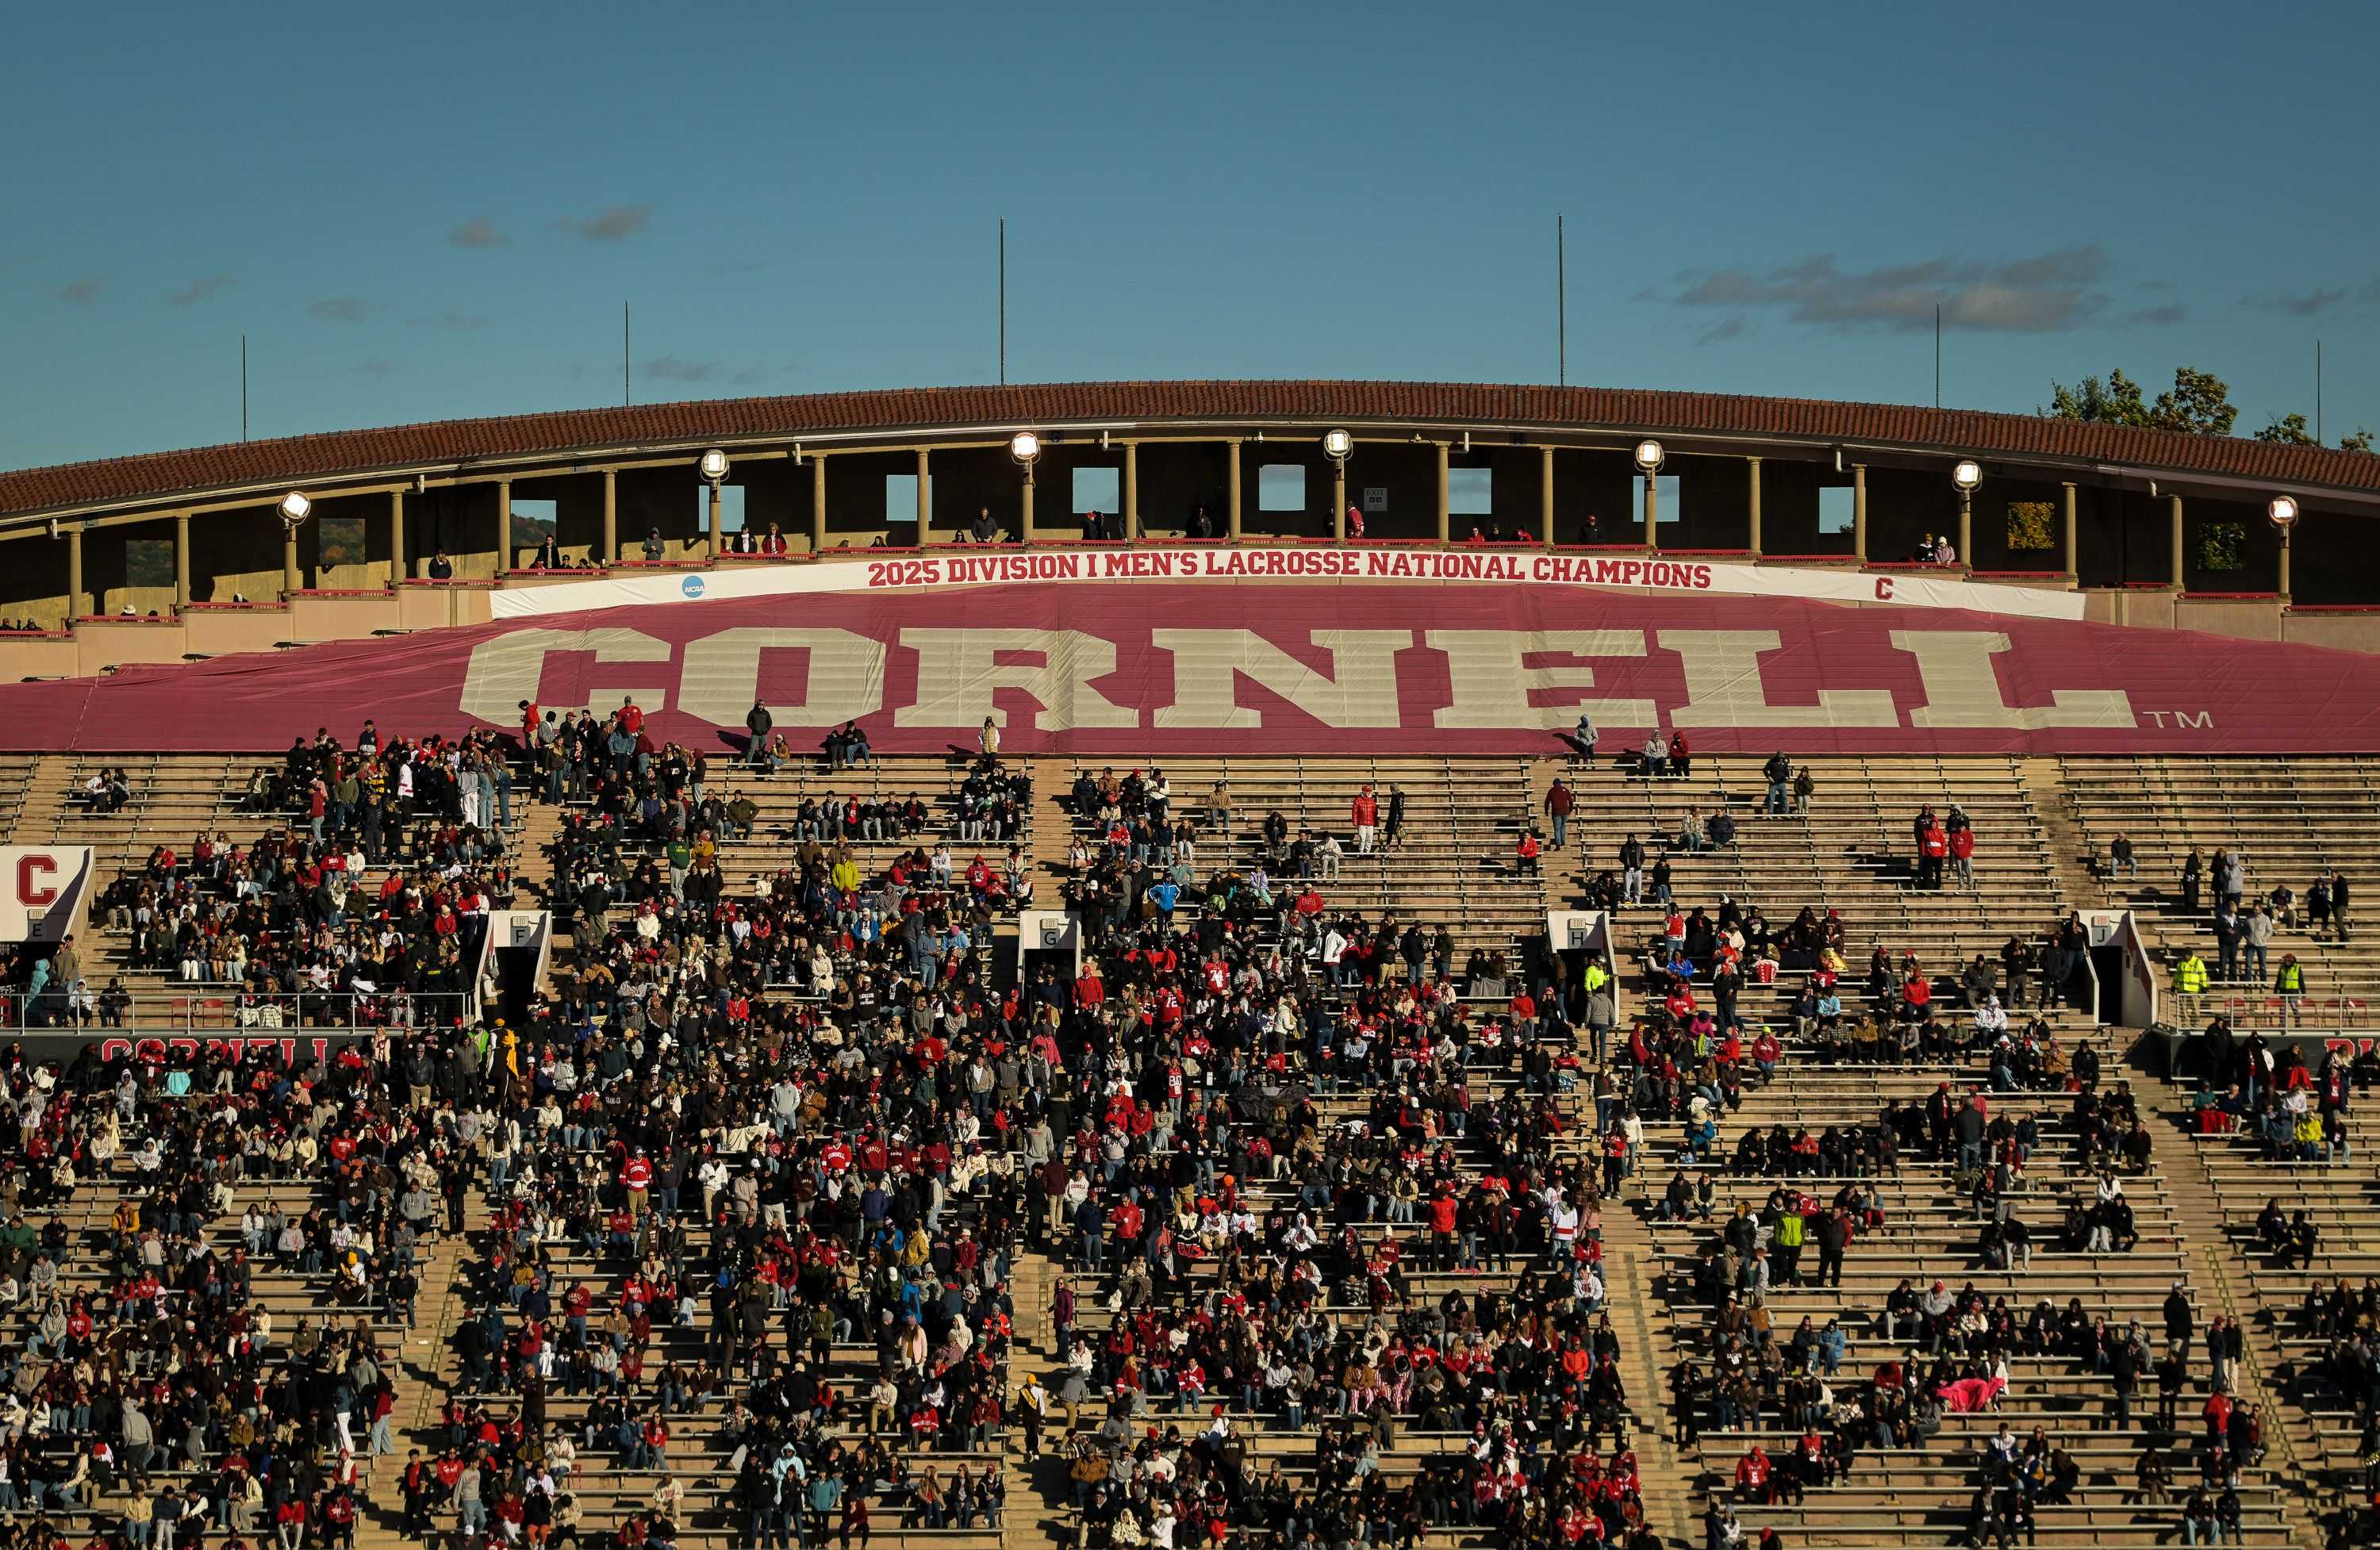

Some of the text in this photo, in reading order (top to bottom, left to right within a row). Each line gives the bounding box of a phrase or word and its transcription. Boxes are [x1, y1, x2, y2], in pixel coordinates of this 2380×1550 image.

[869, 551, 1711, 589] 2025 DIVISION I MEN'S LACROSSE NATIONAL CHAMPIONS
[1875, 577, 1893, 600] C
[459, 627, 2214, 731] CORNELL TM
[16, 854, 57, 907] C
[33, 923, 42, 937] E
[516, 929, 525, 943] F
[2097, 929, 2105, 942] J
[1044, 931, 1056, 946] G
[1572, 931, 1583, 945] H
